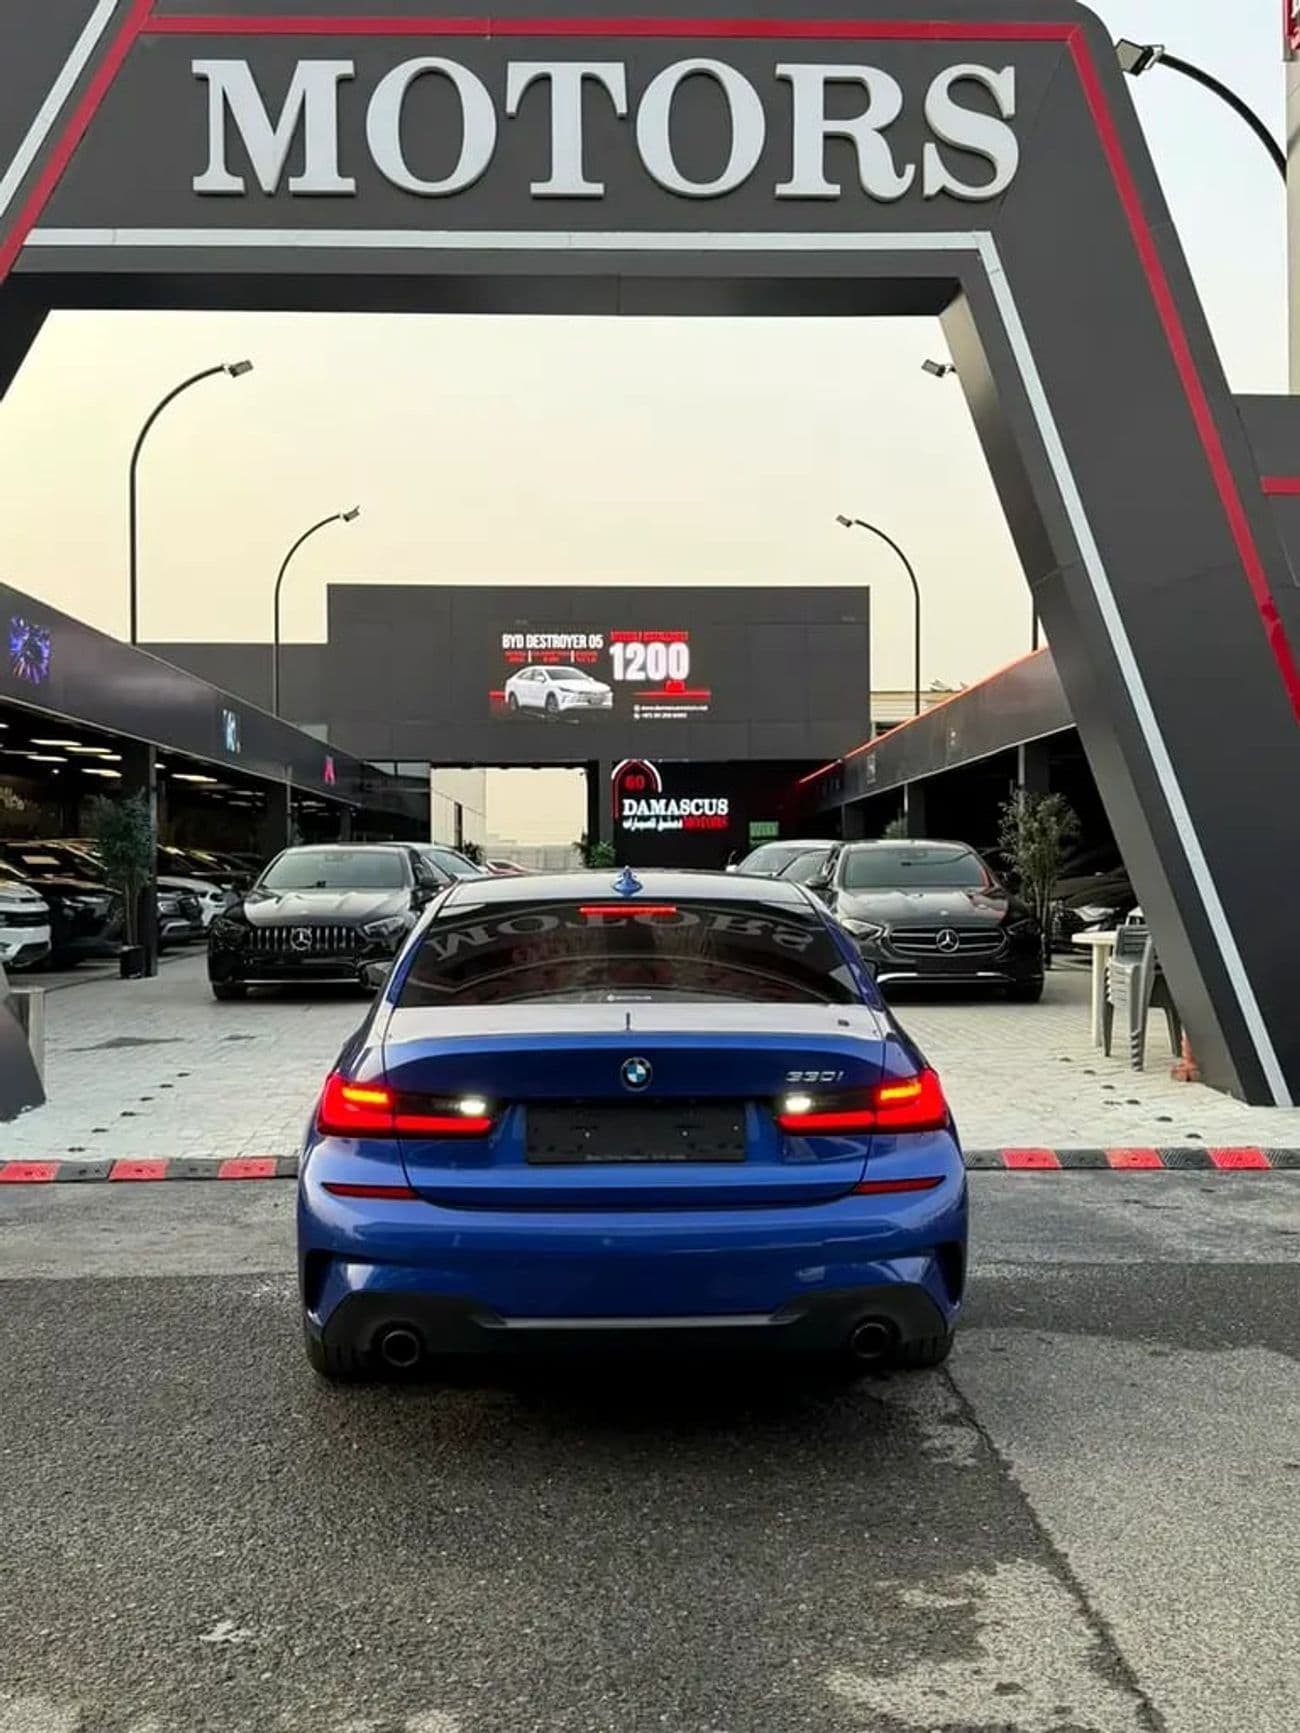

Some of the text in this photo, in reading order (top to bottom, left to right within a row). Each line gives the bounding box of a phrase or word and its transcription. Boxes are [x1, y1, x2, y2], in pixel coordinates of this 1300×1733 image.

[192, 56, 1020, 202] MOTORS
[502, 634, 524, 649] BYD
[526, 634, 586, 649] DESTROYER
[588, 634, 604, 649] 05
[609, 642, 690, 681] 1200
[622, 798, 729, 816] DAMASCUS
